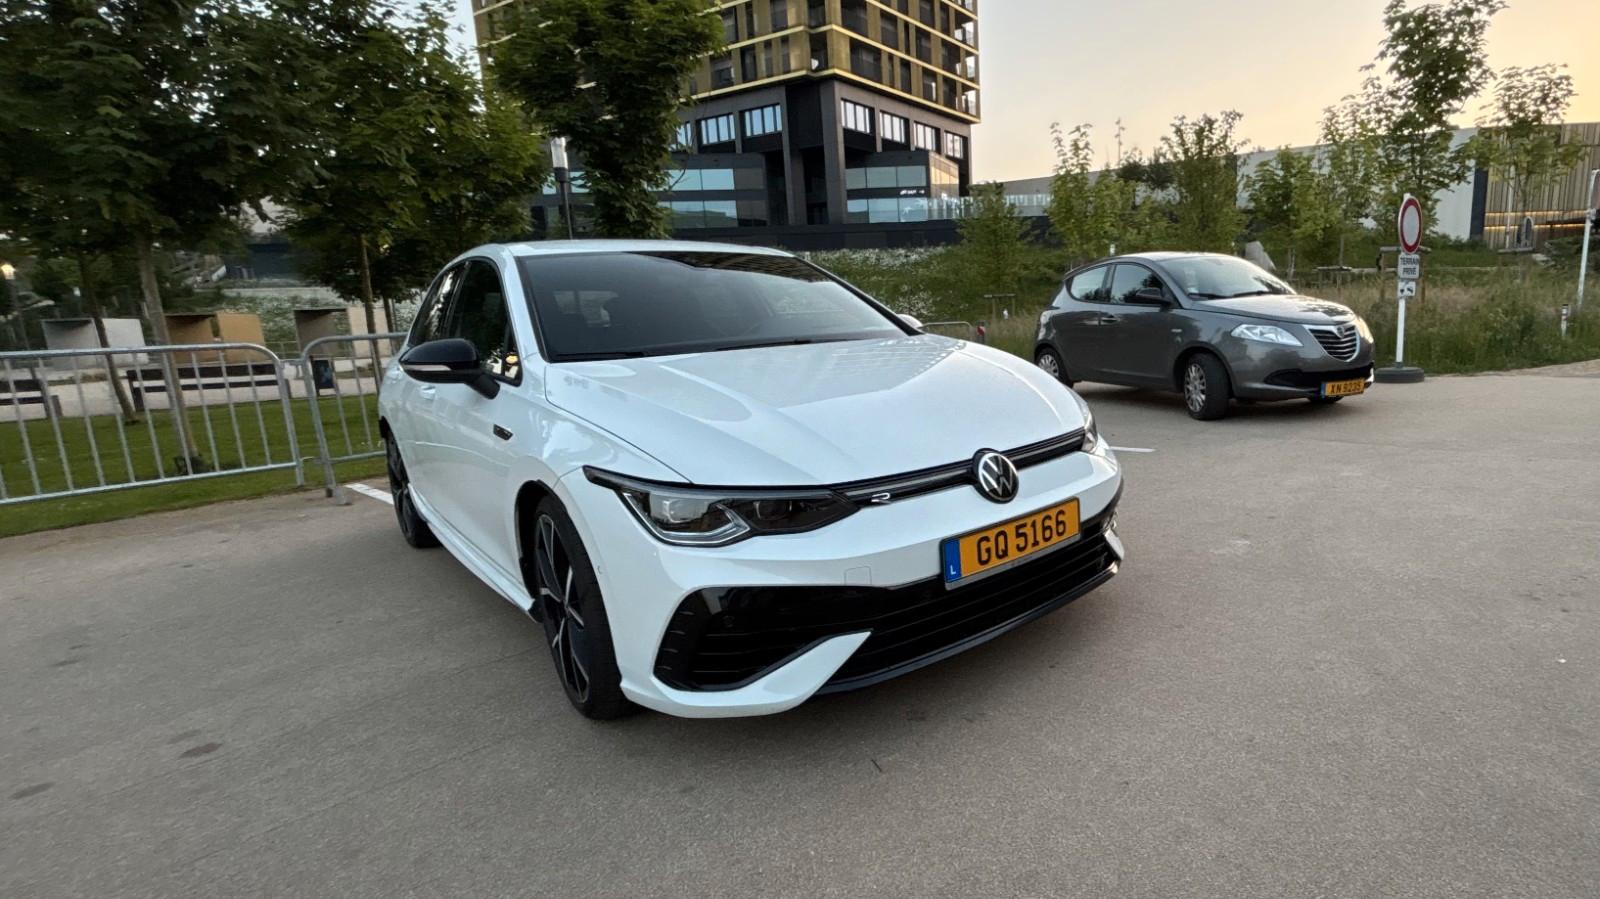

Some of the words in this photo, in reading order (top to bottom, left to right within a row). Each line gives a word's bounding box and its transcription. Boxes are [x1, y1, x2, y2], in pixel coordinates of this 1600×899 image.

[1400, 257, 1419, 266] TERRAIN
[1331, 384, 1342, 394] XN
[871, 492, 893, 504] R
[977, 530, 1008, 566] GQ
[1015, 509, 1067, 552] 5166
[949, 565, 957, 575] L
